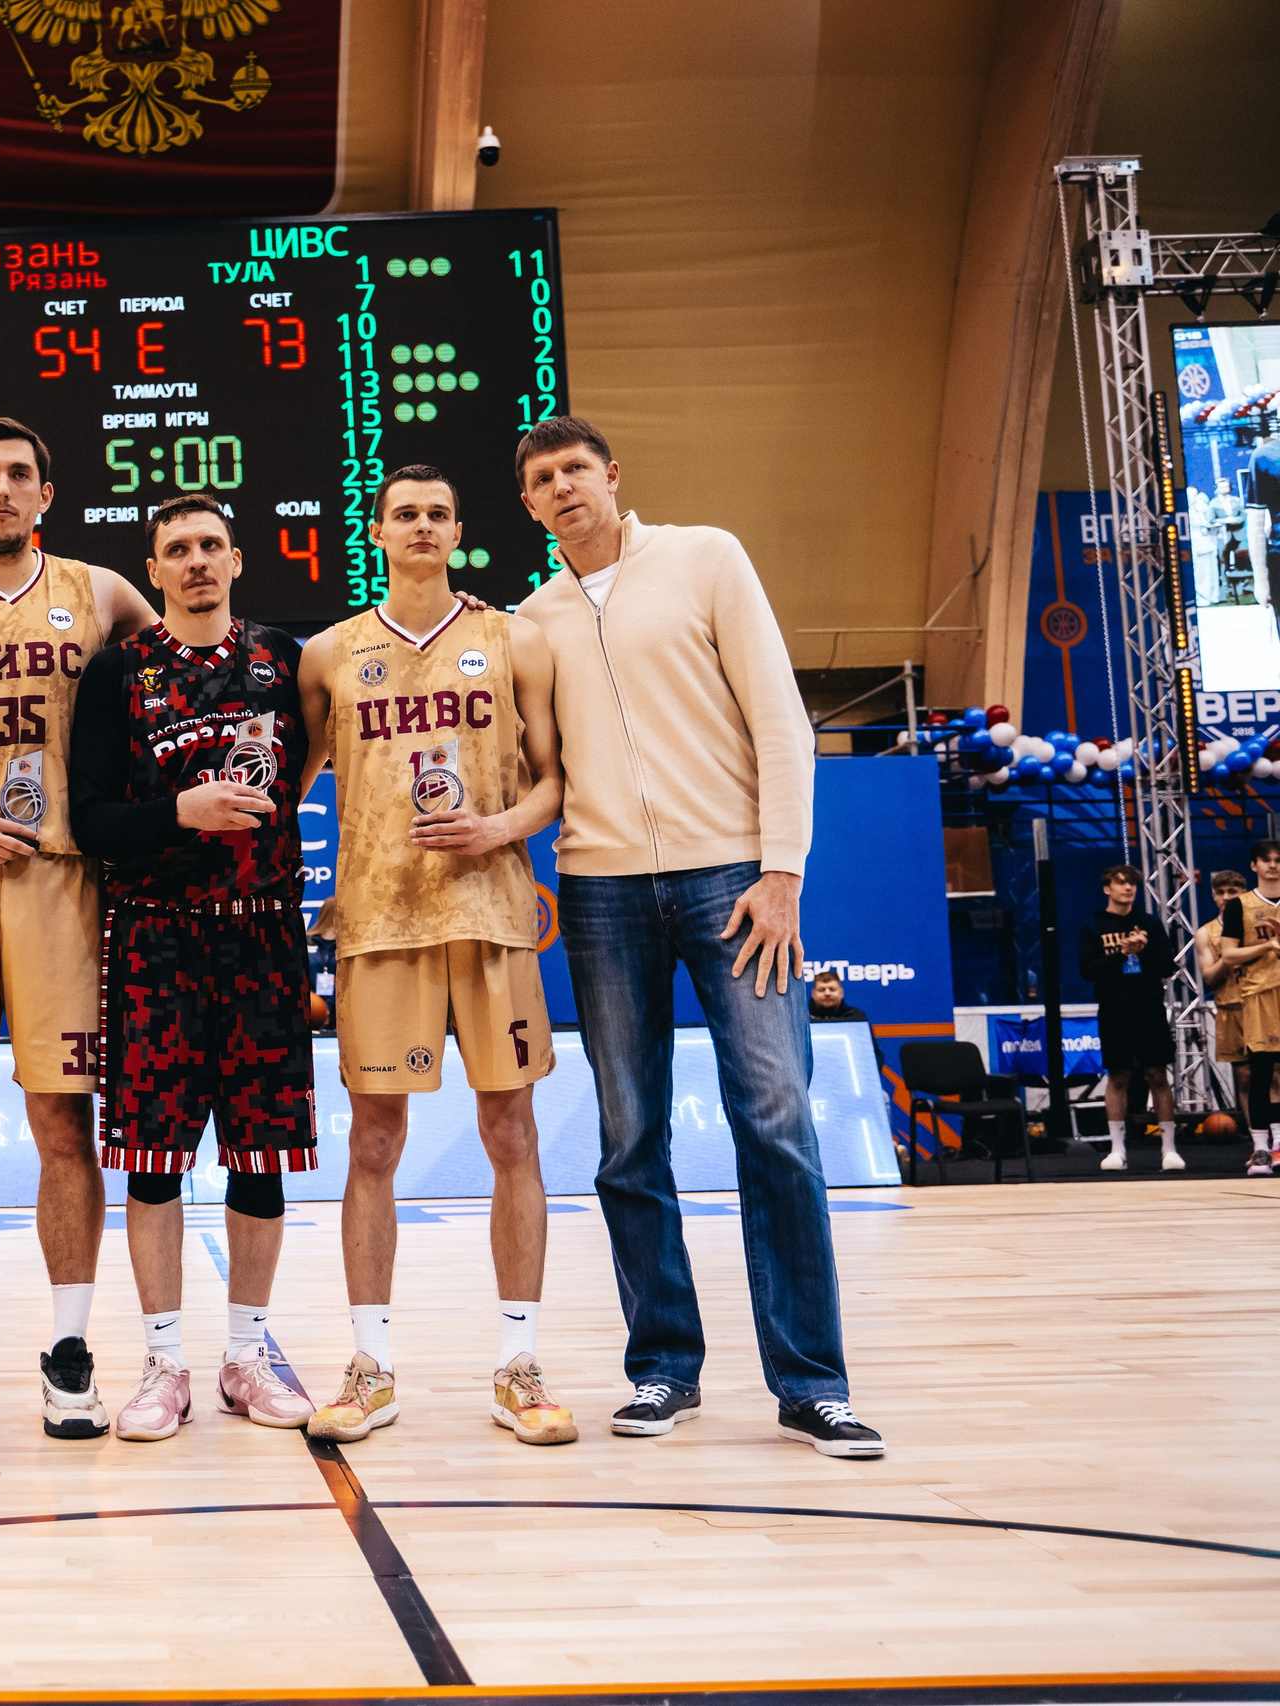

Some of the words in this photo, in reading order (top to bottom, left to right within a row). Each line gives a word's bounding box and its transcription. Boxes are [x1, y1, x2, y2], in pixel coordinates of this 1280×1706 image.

[250, 225, 349, 260] ЦИВС
[207, 257, 276, 284] ТУЛА
[355, 255, 370, 283] 1
[508, 249, 544, 278] 11
[9, 270, 108, 291] Рязань
[530, 277, 551, 306] 0
[44, 299, 88, 316] СЧЕТ
[119, 296, 185, 313] ПЕРИОД
[249, 292, 293, 309] СЧЕТ
[355, 283, 376, 312] 7
[336, 312, 377, 341] 10
[532, 306, 553, 335] 0
[34, 325, 101, 379] 54
[243, 316, 307, 370] 73
[338, 341, 374, 370] 11
[534, 335, 555, 364] 2
[112, 382, 198, 400] ТАЙМАУТЫ
[339, 370, 380, 399] 13
[536, 364, 556, 393] 0
[102, 412, 157, 430] ВРЕМЯ
[165, 411, 209, 428] ИГРЫ
[340, 398, 382, 428] 15
[517, 393, 557, 423] 12
[342, 428, 383, 458] 17
[106, 435, 243, 493] 5:00
[342, 457, 385, 488] 23
[84, 506, 139, 524] ВРЕМЯ
[275, 500, 321, 517] ФОЛЫ
[279, 527, 320, 582] 4
[346, 547, 384, 577] 31
[347, 576, 390, 607] 35
[253, 667, 273, 678] РФБ
[461, 659, 485, 668] РФБ
[144, 697, 167, 709] STK
[356, 690, 493, 741] ЦИВС
[1195, 691, 1280, 725] ВЕР
[152, 722, 284, 767] РЯЗАЬ
